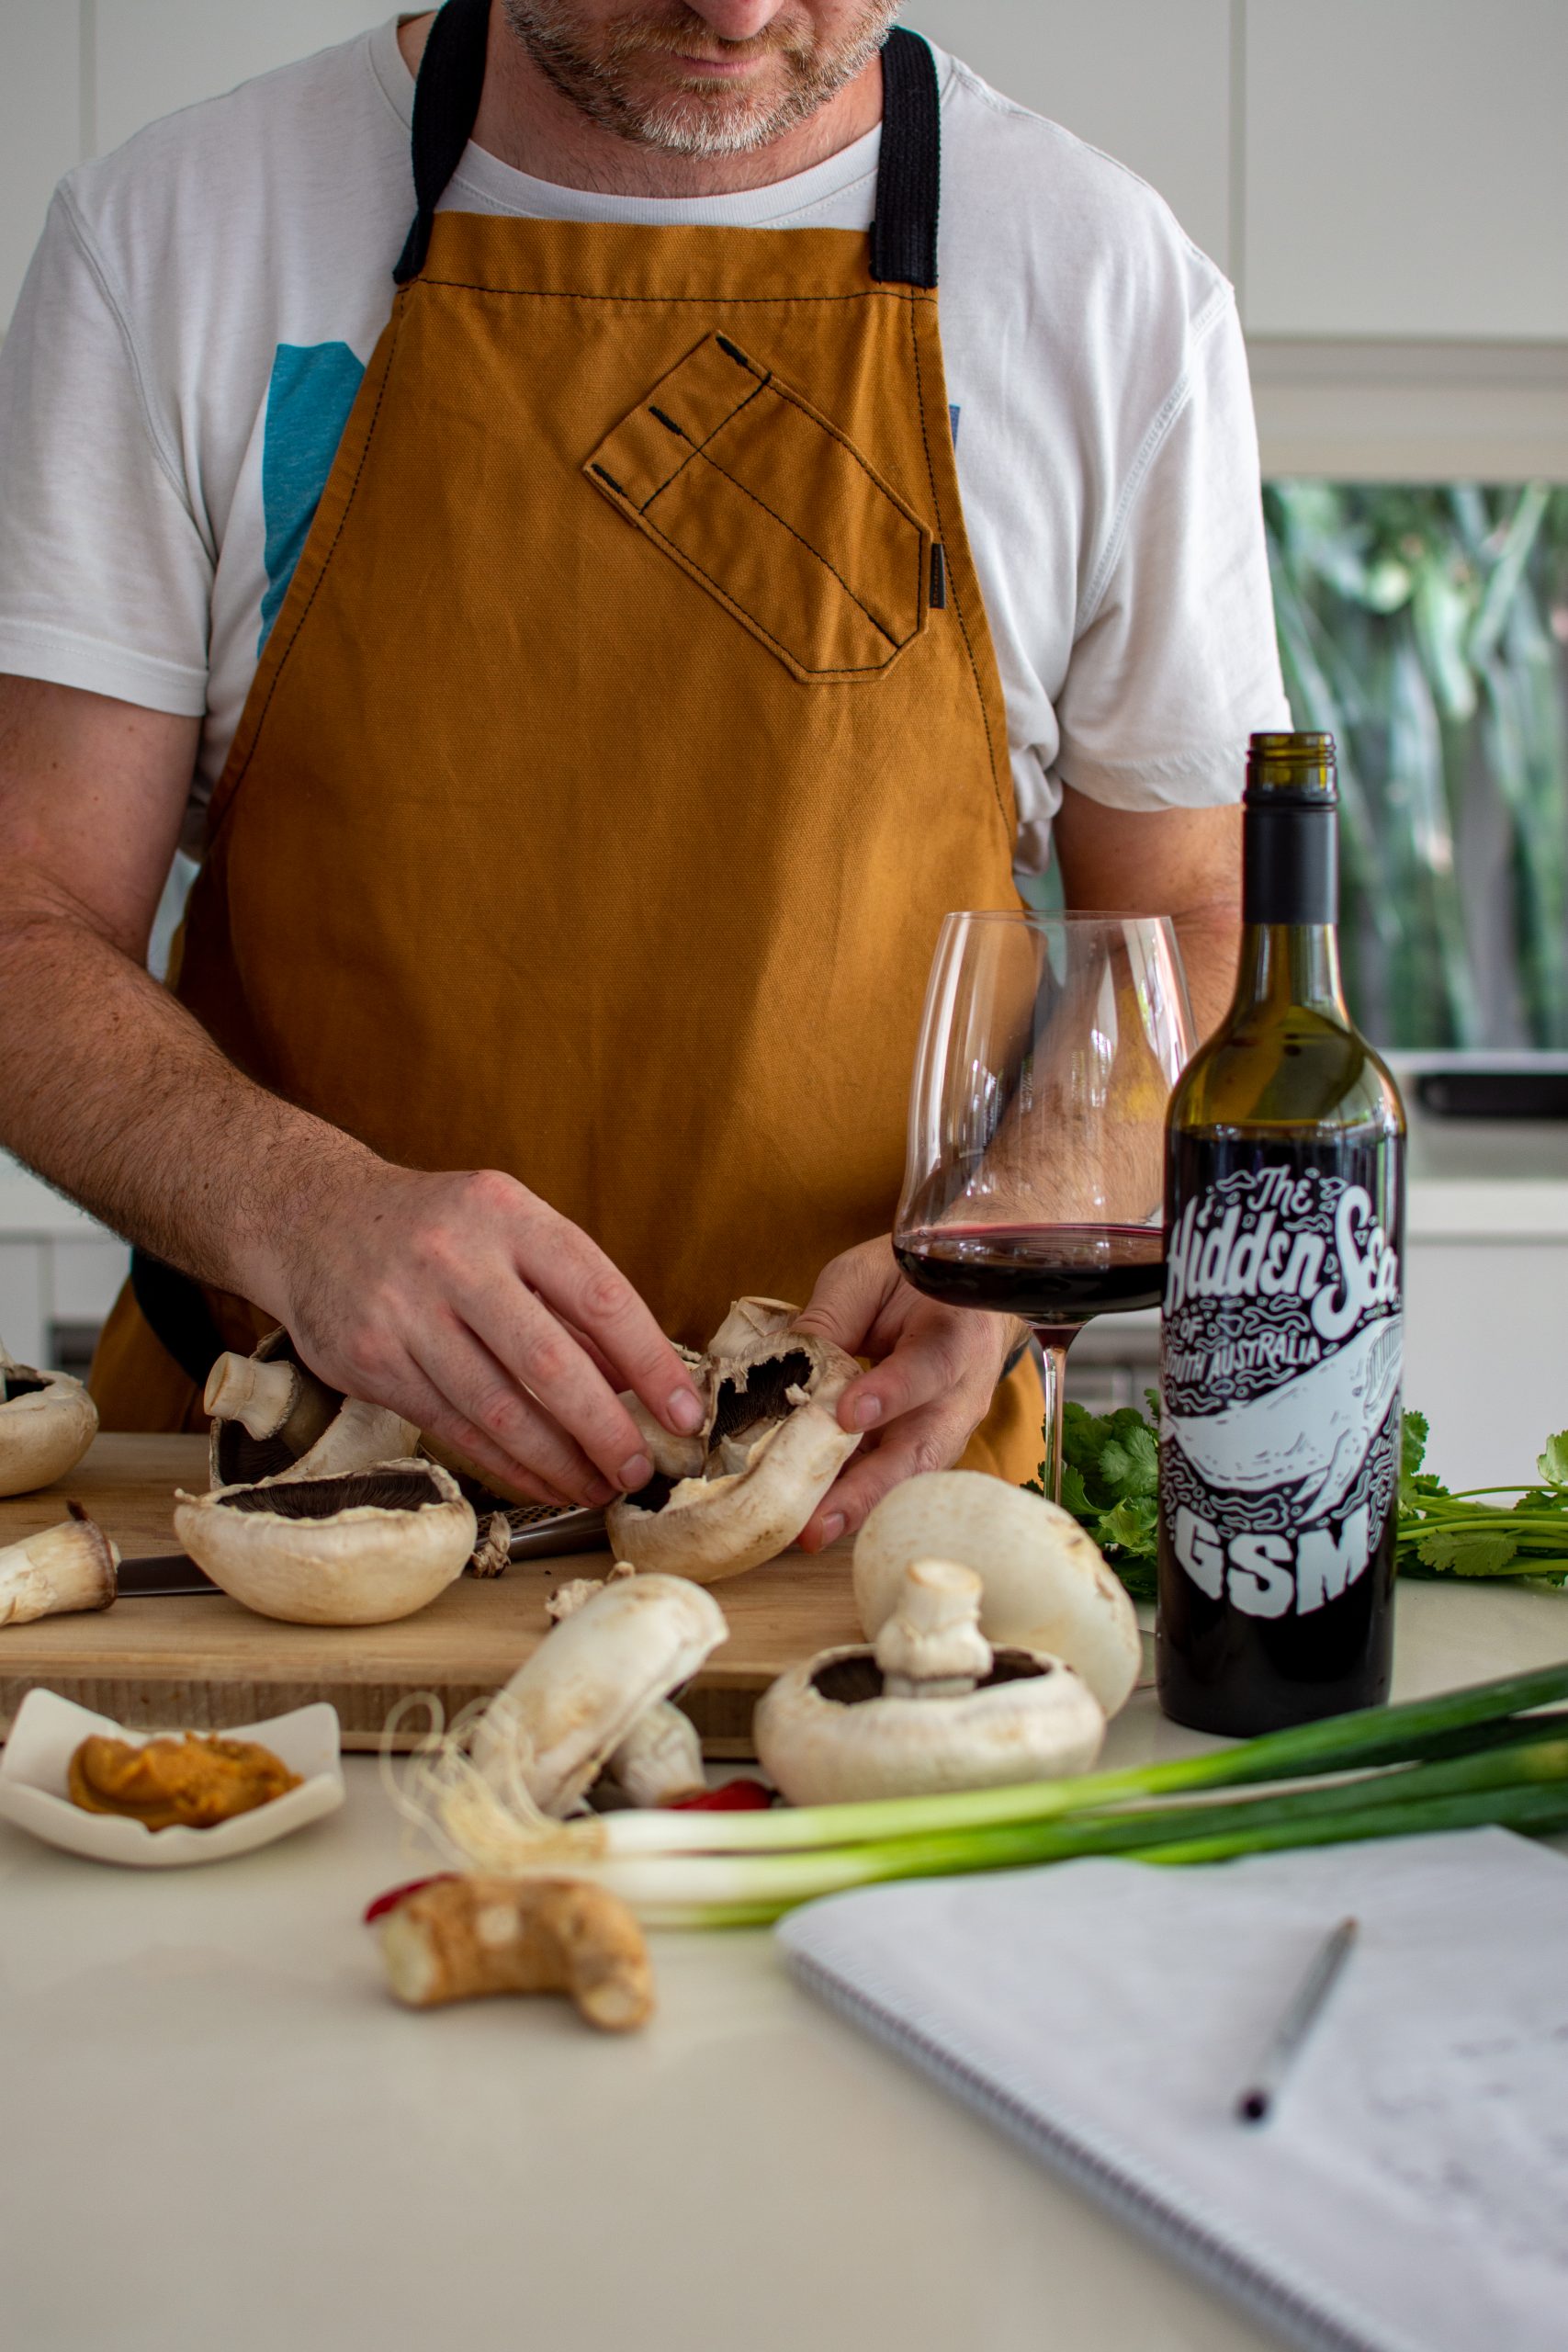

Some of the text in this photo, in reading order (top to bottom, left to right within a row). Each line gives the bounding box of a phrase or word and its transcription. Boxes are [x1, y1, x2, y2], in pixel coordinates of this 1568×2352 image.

[1247, 1164, 1314, 1217] The
[1312, 1185, 1398, 1340] Sea
[1205, 1332, 1320, 1385] AUSTRALIA
[1175, 1503, 1369, 1619] GSM
